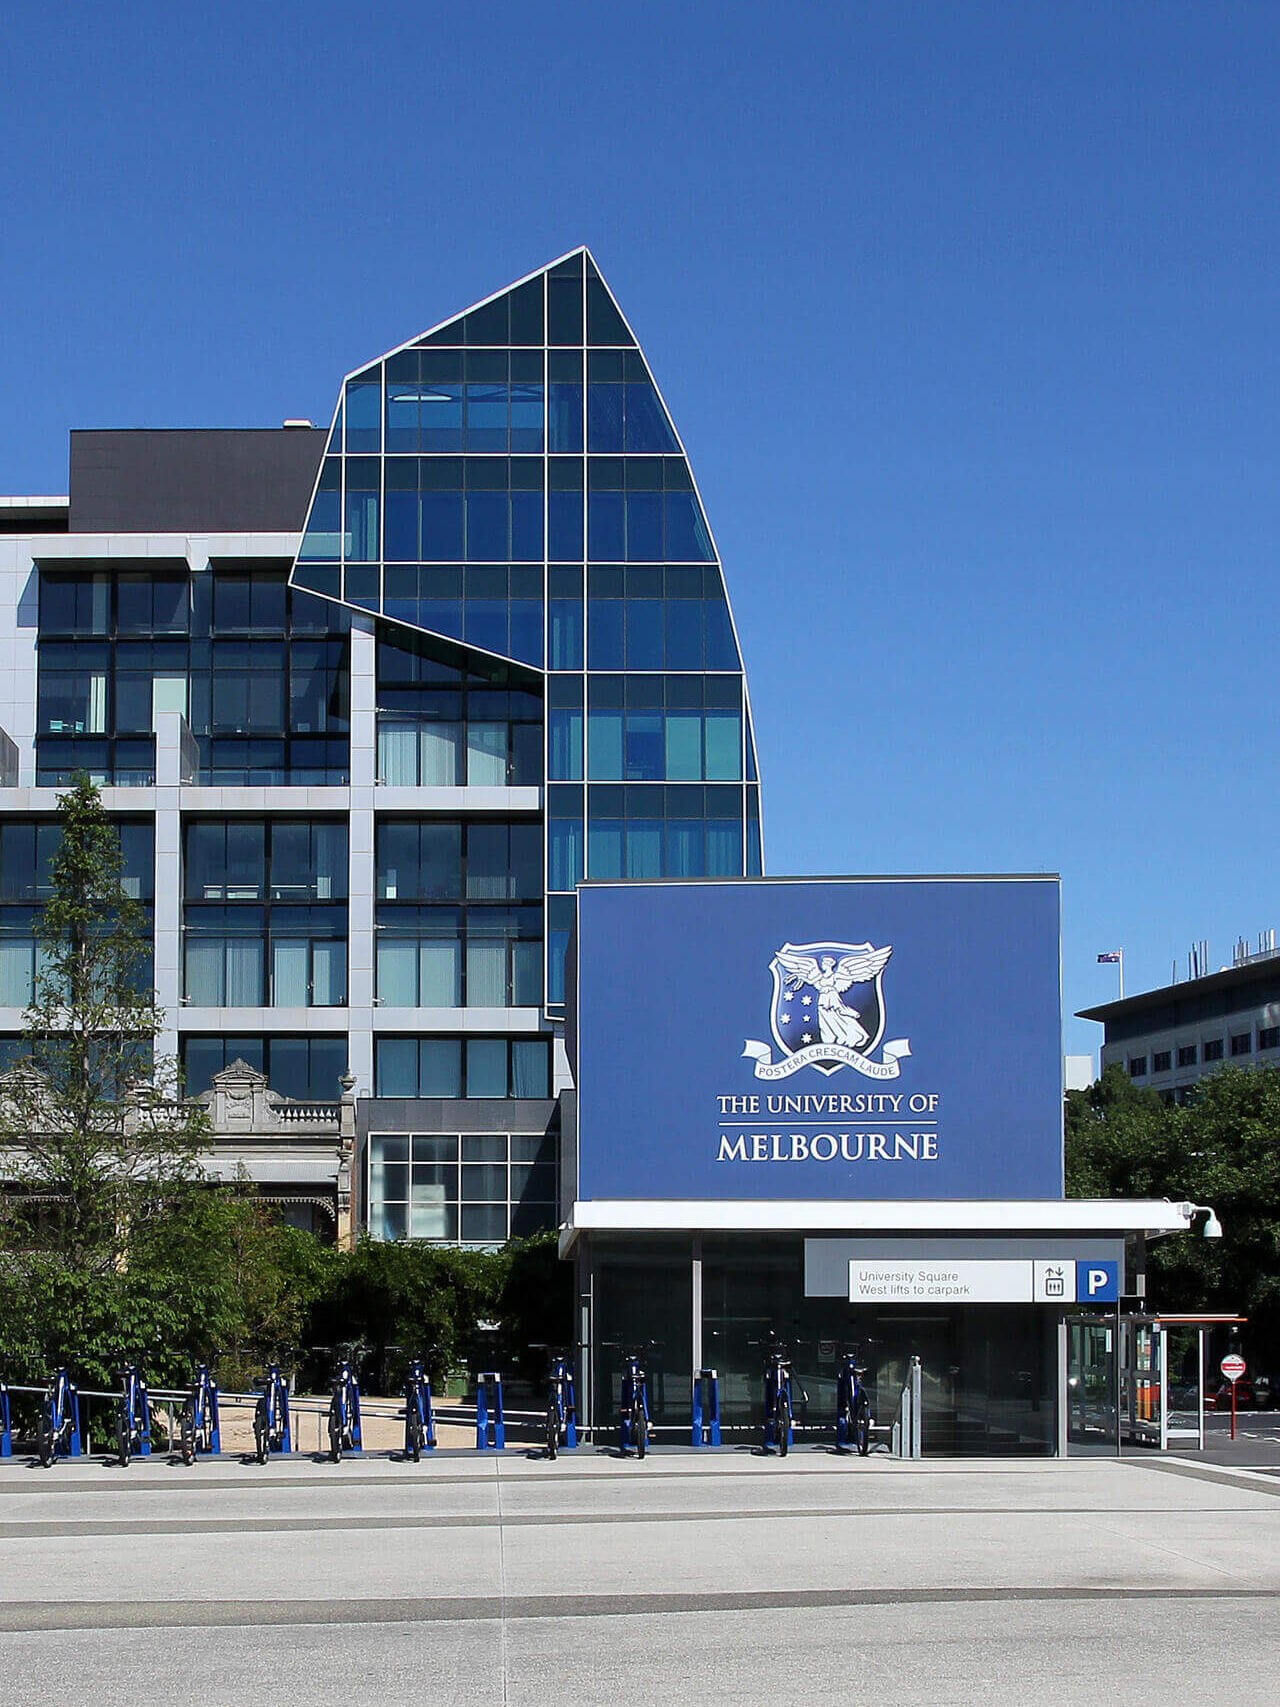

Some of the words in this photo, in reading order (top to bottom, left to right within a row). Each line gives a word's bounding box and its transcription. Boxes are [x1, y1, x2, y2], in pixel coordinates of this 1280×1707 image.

[758, 1053, 807, 1077] POSTERA
[808, 1047, 859, 1066] CRESCAM
[859, 1060, 896, 1076] LAUDE
[717, 1095, 760, 1114] THE
[766, 1094, 903, 1114] UNIVERSITY
[908, 1094, 939, 1113] OF
[716, 1132, 939, 1162] MELBOURNE
[858, 1271, 915, 1284] University
[918, 1271, 959, 1284] Square
[1088, 1269, 1109, 1295] P
[858, 1284, 888, 1296] West
[890, 1284, 911, 1296] lifts
[913, 1285, 926, 1296] to
[927, 1284, 970, 1298] carpark
